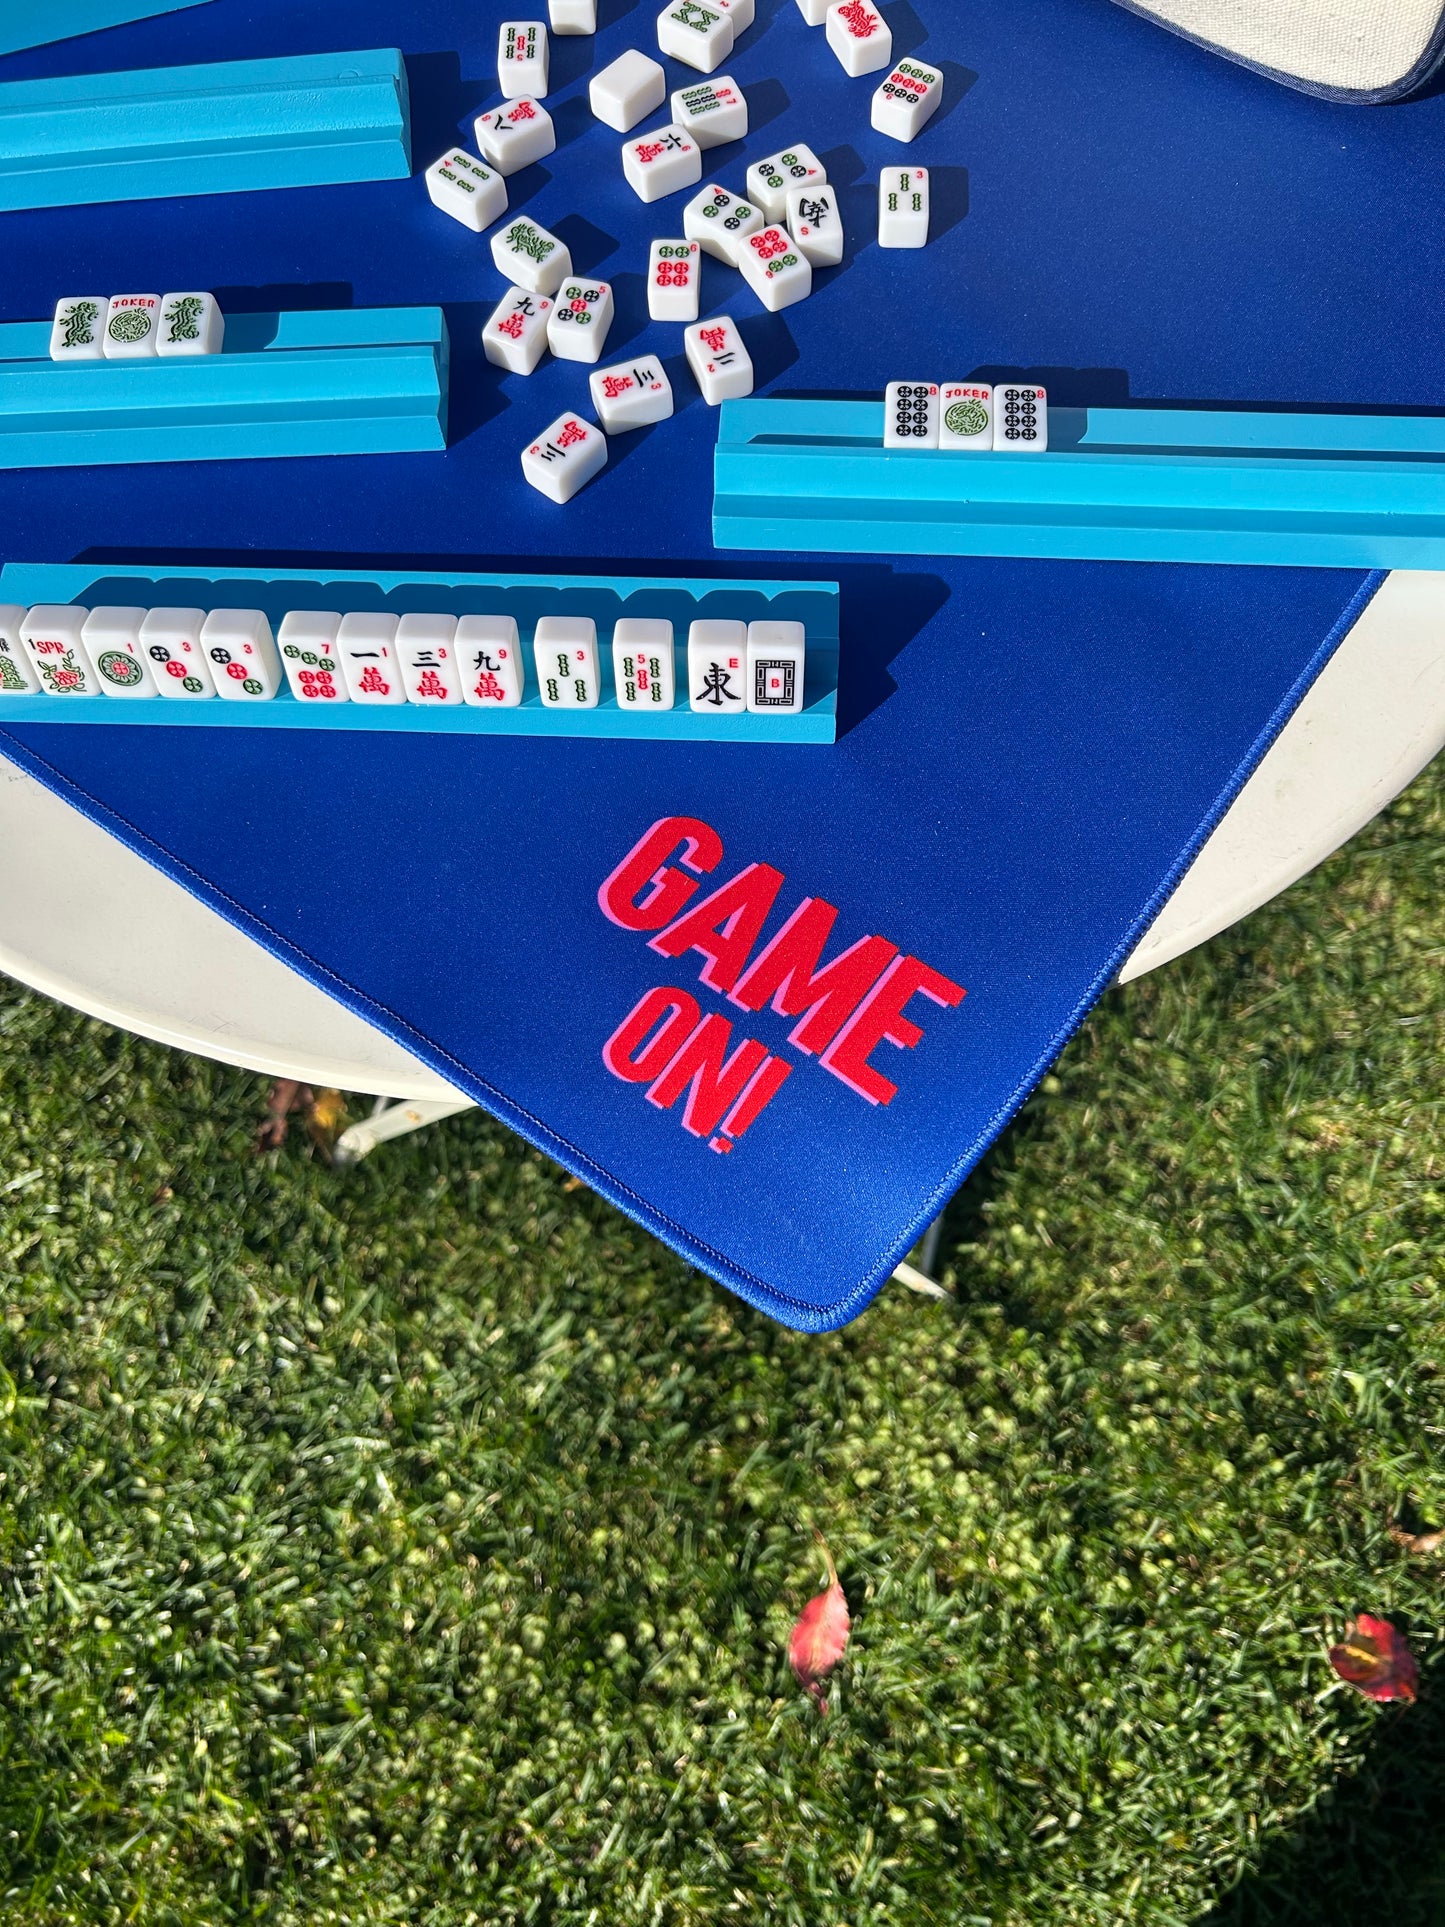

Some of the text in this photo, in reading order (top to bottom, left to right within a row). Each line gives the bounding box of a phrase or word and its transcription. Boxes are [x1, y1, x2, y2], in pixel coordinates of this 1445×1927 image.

[516, 53, 525, 62] 5
[726, 97, 737, 106] 7
[481, 114, 492, 122] 8
[444, 158, 454, 168] 4
[808, 168, 818, 176] 4
[916, 170, 924, 180] 3
[800, 226, 810, 236] S
[690, 243, 698, 252] 6
[598, 285, 608, 294] 5
[112, 298, 155, 309] JOKER
[540, 300, 550, 310] 9
[706, 364, 716, 374] 2
[650, 382, 662, 390] 3
[929, 387, 937, 396] 8
[945, 388, 988, 400] JOKER
[1037, 390, 1045, 399] 8
[529, 446, 541, 456] 3
[28, 638, 66, 654] 1 SPR
[126, 642, 134, 654] 1
[182, 641, 192, 652] 3
[244, 644, 254, 654] 3
[322, 644, 331, 655] 7
[382, 646, 388, 658] 1
[438, 648, 448, 660] 3
[498, 648, 508, 660] 9
[576, 650, 586, 661] 3
[637, 654, 646, 664] 5
[728, 657, 740, 668] E
[694, 662, 742, 706] 東
[771, 678, 780, 689] B
[597, 815, 968, 1106] GAME
[602, 986, 793, 1155] ON!
